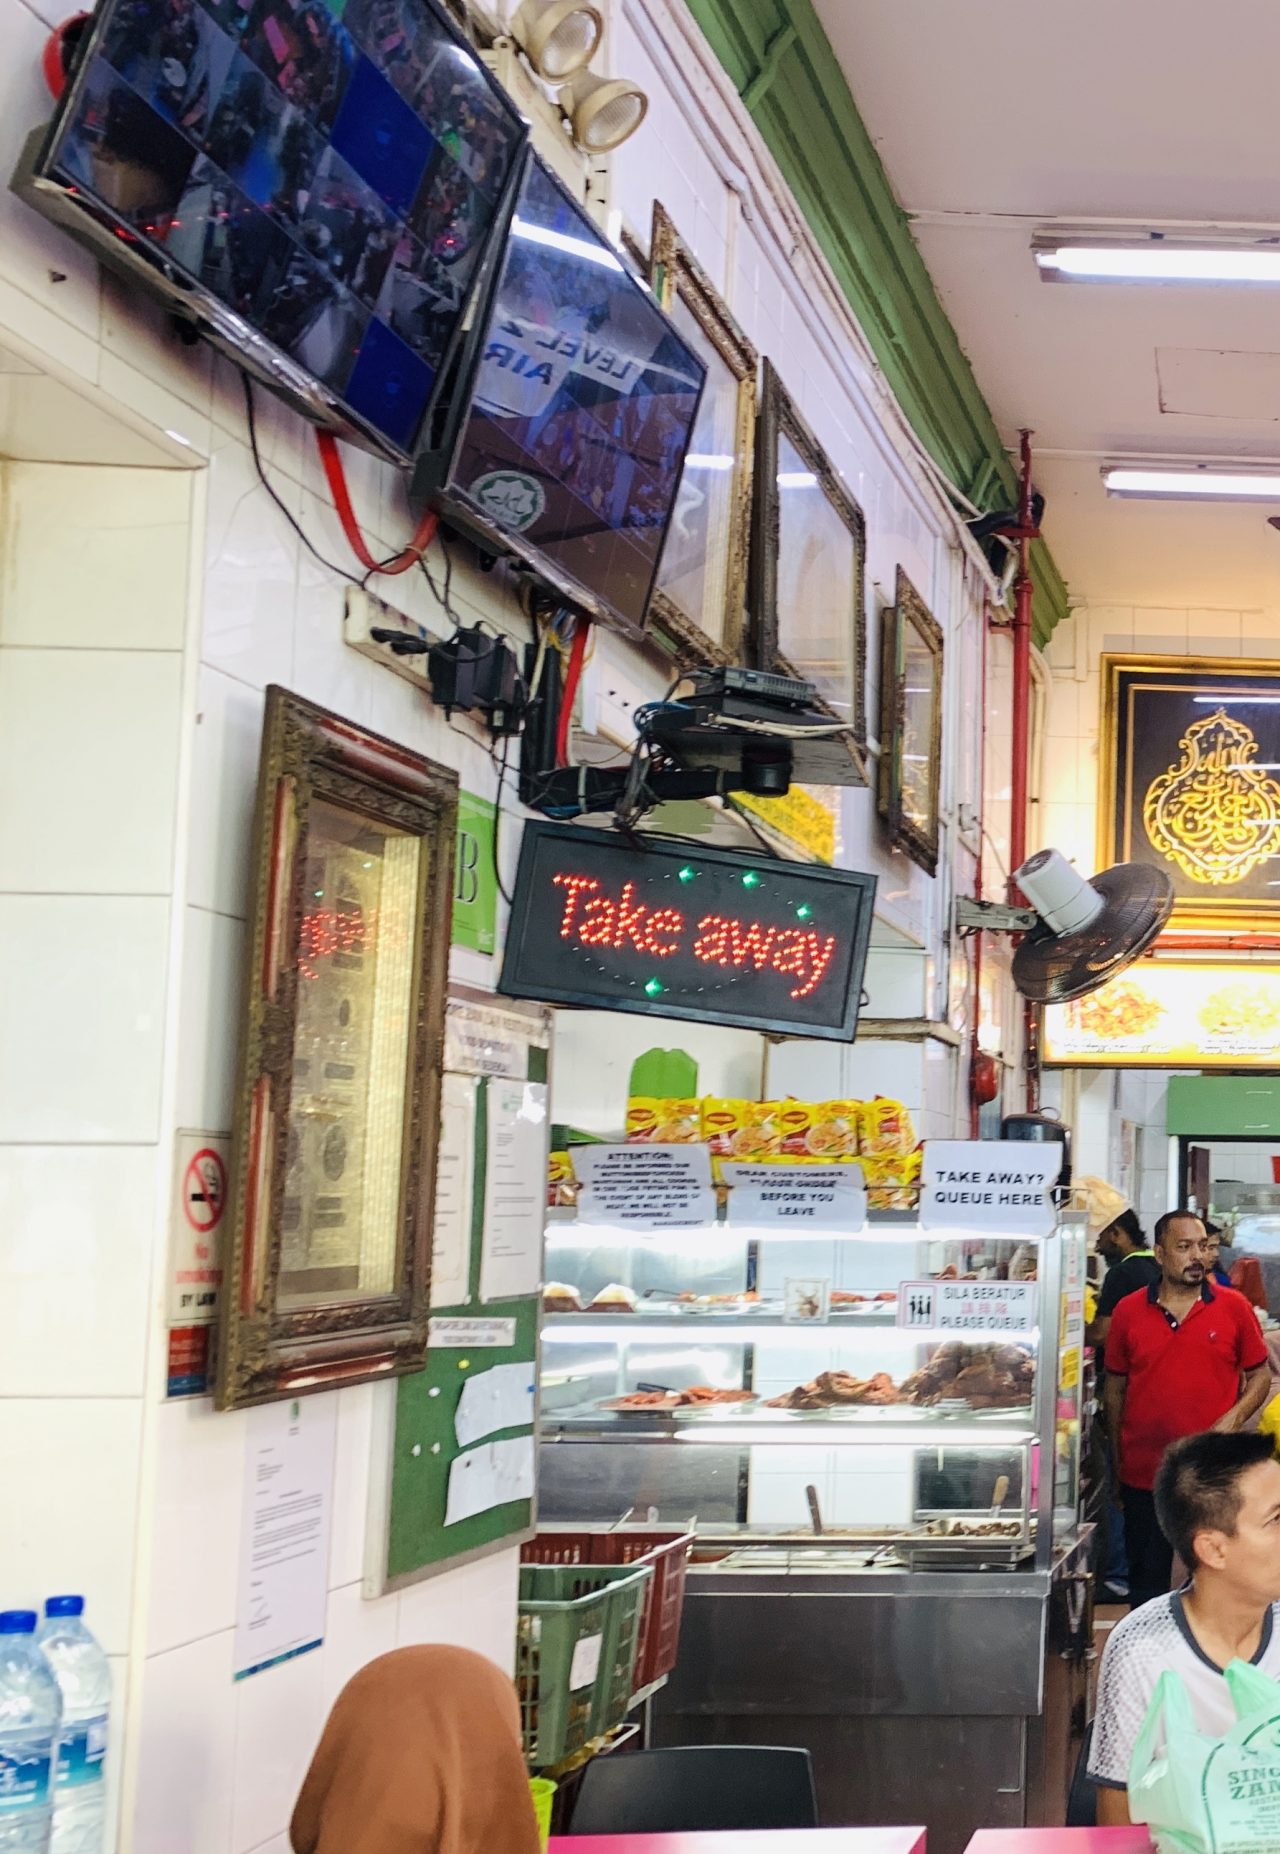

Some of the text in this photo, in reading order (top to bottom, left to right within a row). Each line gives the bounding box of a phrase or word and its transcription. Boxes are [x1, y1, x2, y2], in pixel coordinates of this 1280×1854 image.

[552, 873, 836, 999] Take away
[936, 1171, 1045, 1185] TAKE AWAY?
[760, 1193, 834, 1202] BEFORE YOU
[935, 1192, 1043, 1205] QUEUE HERE
[778, 1207, 815, 1216] LEAVE
[941, 1316, 1027, 1330] PLEASE QUEUE
